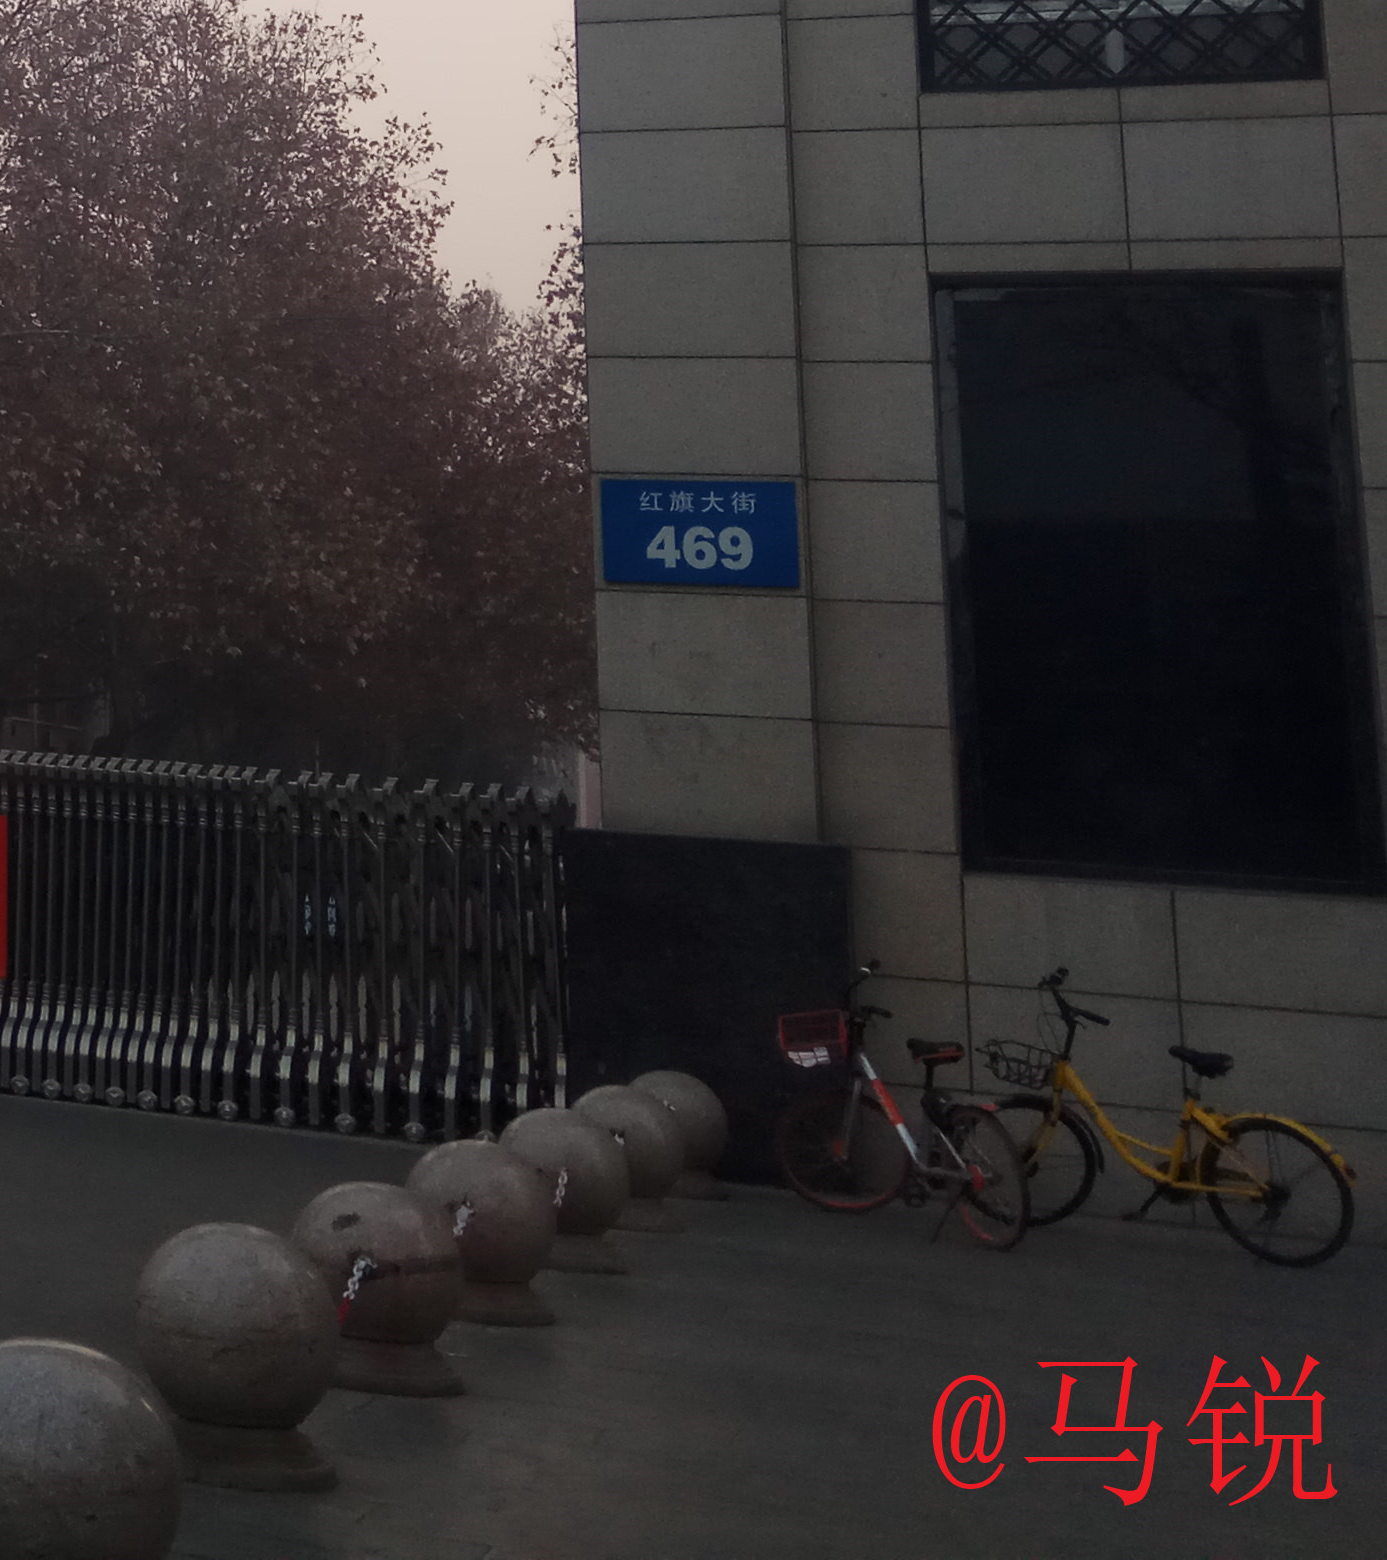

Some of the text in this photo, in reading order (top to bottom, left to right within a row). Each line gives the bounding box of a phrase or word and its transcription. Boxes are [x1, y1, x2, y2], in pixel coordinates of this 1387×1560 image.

[639, 491, 757, 515] 红旗大街
[646, 525, 753, 571] 469
